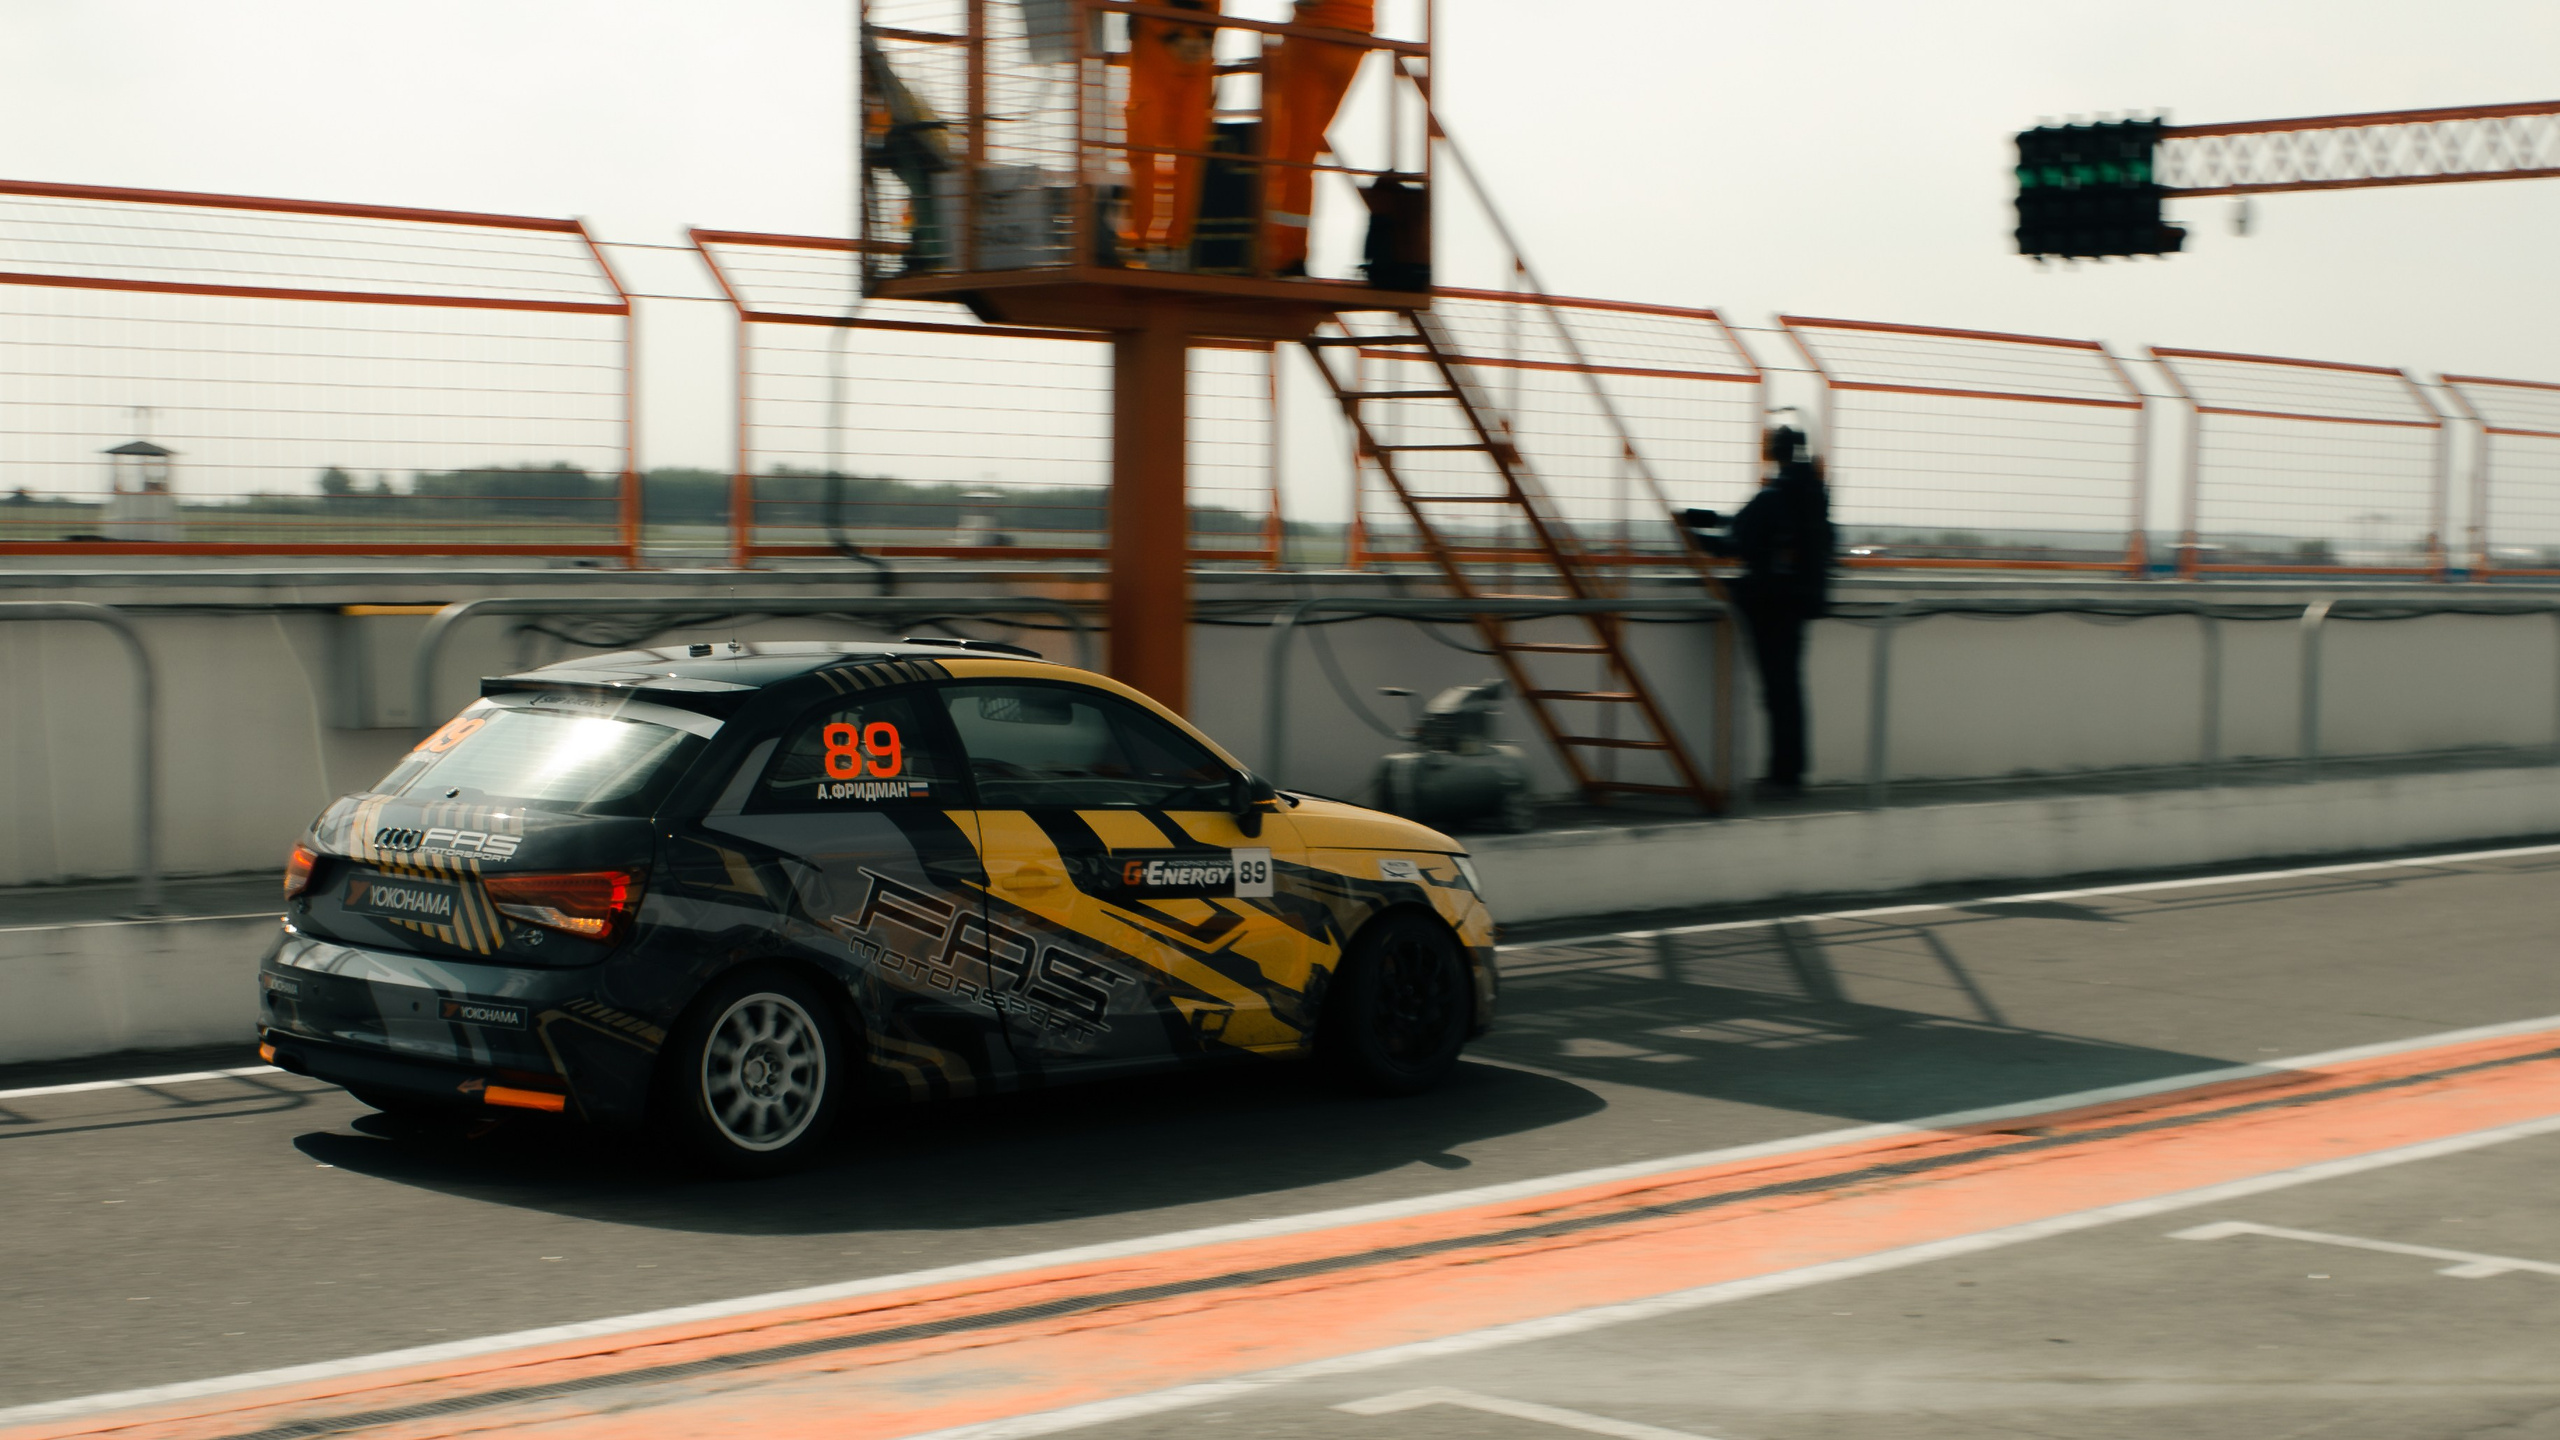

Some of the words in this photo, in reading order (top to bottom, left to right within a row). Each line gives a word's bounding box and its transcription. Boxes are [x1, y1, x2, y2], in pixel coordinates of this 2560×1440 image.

[823, 721, 902, 780] 89
[817, 781, 909, 801] А.ФРИДМАН
[418, 846, 512, 863] MOTORSPORT
[421, 827, 522, 856] FAS
[1240, 860, 1267, 884] 89
[369, 884, 450, 916] YOKOHAMA
[831, 866, 1136, 1032] FAS
[850, 935, 1096, 1044] MOTORSPORT
[460, 1004, 519, 1025] YOKOHAMA
